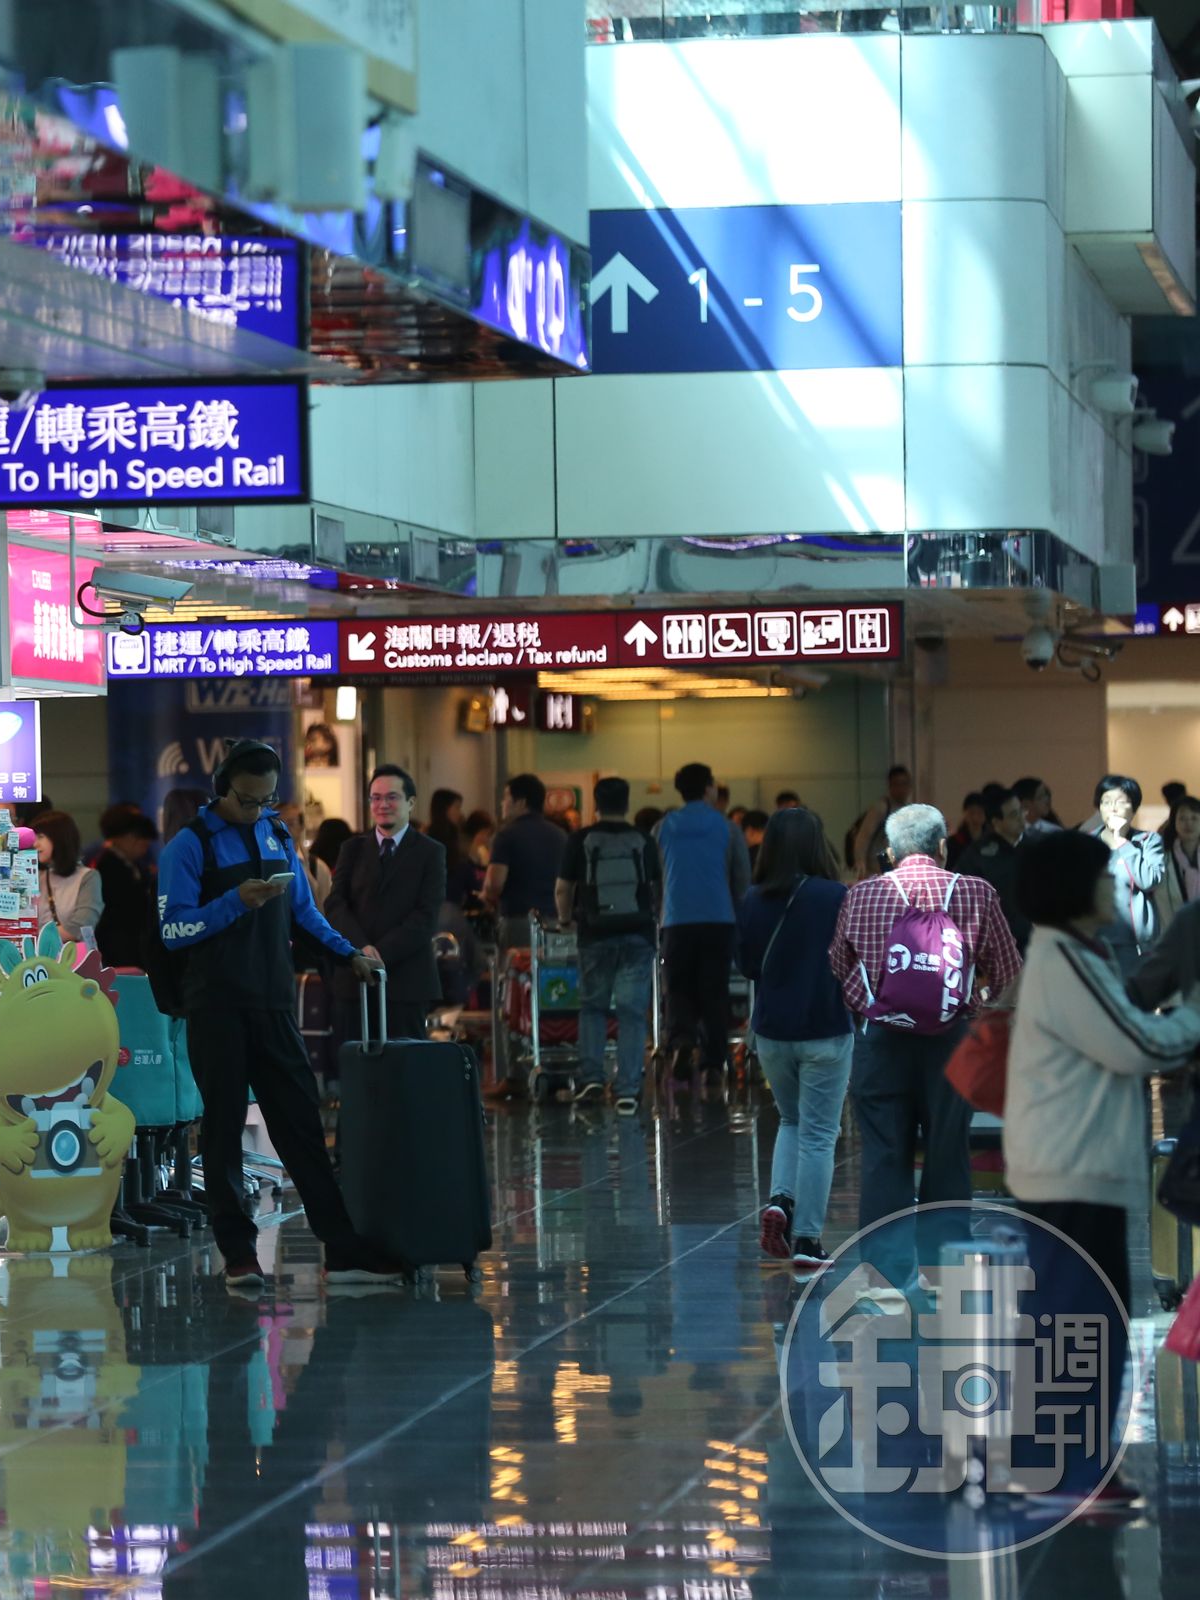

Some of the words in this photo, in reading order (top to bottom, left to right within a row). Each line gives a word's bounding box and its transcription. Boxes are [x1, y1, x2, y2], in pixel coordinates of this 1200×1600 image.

[688, 267, 708, 324] 1
[786, 264, 824, 323] 5
[1, 462, 40, 492] To
[47, 461, 118, 499] High
[126, 456, 224, 497] Speed
[232, 454, 285, 487] Rail
[153, 656, 187, 673] MRT
[198, 656, 217, 673] To
[218, 655, 254, 676] High
[256, 653, 303, 675] Speed
[306, 652, 332, 670] Rail
[384, 651, 453, 668] Customs
[455, 648, 513, 667] declare
[526, 647, 553, 664] Tax
[555, 644, 608, 664] refund
